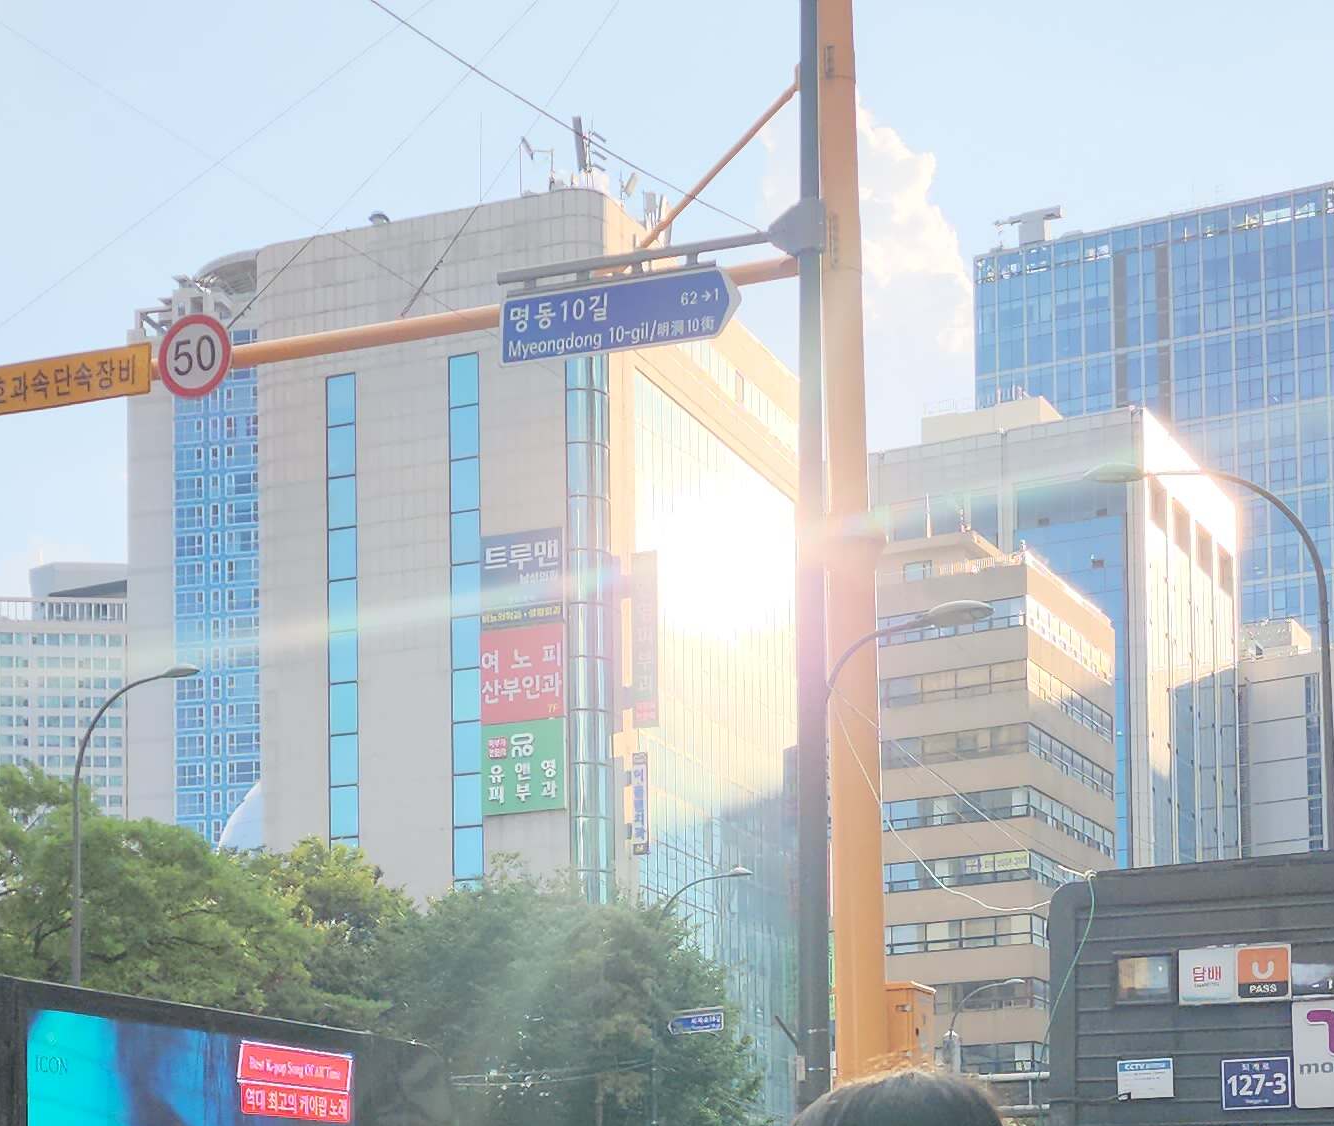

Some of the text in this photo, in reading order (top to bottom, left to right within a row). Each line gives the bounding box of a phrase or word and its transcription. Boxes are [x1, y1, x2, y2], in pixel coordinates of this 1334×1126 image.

[680, 291, 699, 305] 62
[509, 291, 609, 333] 명동10길
[508, 331, 603, 357] Myeongdong
[172, 337, 217, 377] 50
[484, 539, 559, 570] 트루맨
[481, 672, 562, 704] 산부인과
[1192, 965, 1222, 983] 담배
[1249, 984, 1278, 994] PASS
[1226, 1072, 1287, 1097] 127-3
[245, 1088, 266, 1112] 역대
